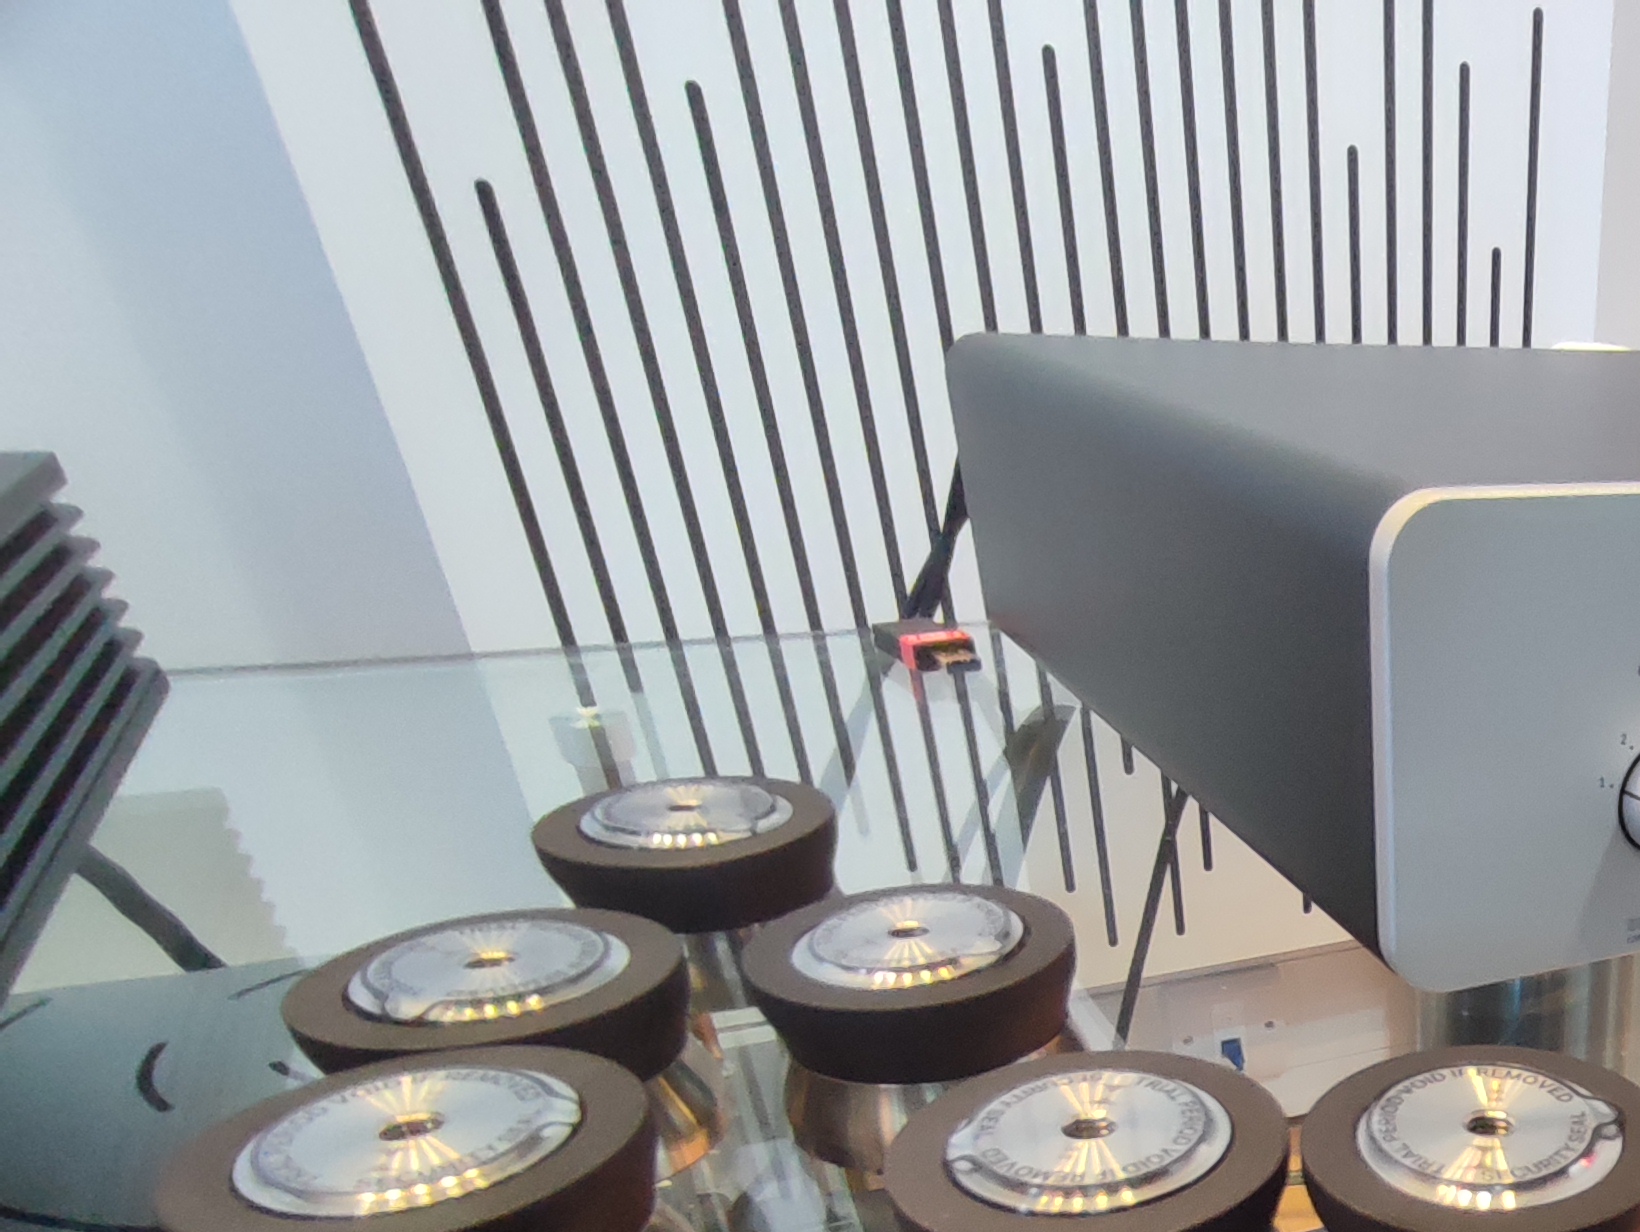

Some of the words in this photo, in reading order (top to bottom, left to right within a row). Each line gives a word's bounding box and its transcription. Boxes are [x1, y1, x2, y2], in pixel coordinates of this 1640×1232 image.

[1620, 733, 1627, 746] 2
[1397, 1071, 1446, 1095] VOID
[1477, 1067, 1574, 1103] REMOVED
[1567, 1110, 1588, 1143] SEAL
[1122, 1146, 1183, 1174] VOID
